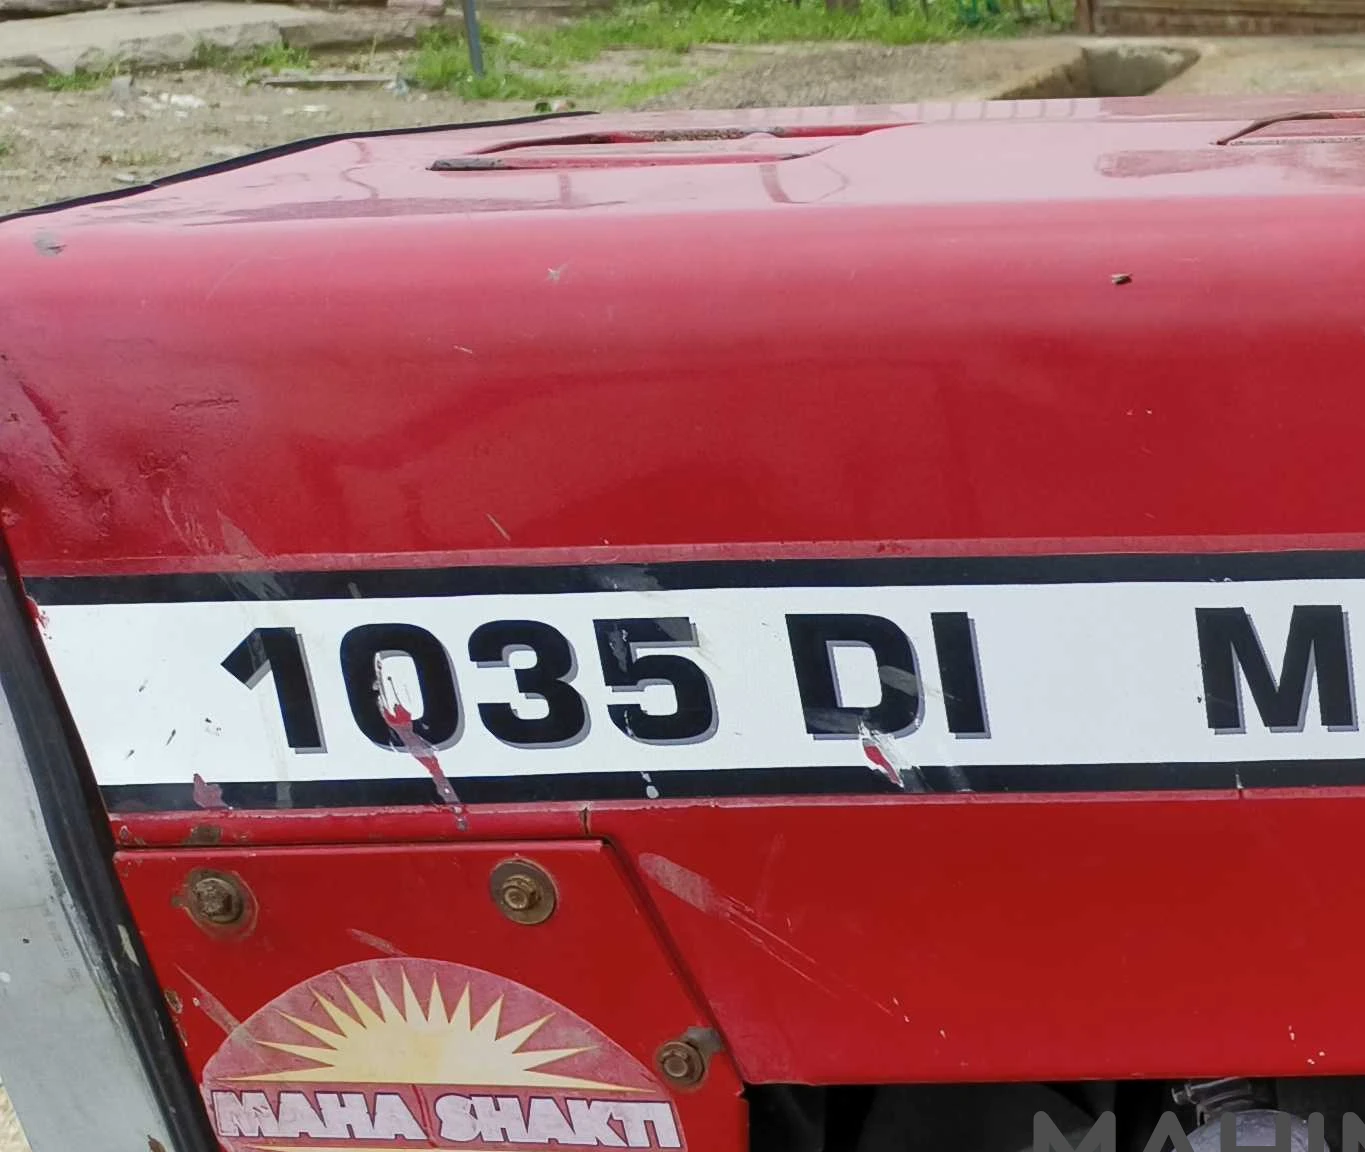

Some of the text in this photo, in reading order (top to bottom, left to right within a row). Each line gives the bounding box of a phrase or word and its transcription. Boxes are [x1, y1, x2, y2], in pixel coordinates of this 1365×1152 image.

[222, 616, 718, 754] 1035
[785, 611, 992, 741] DI
[211, 1089, 684, 1149] MAHA SHAKTI
